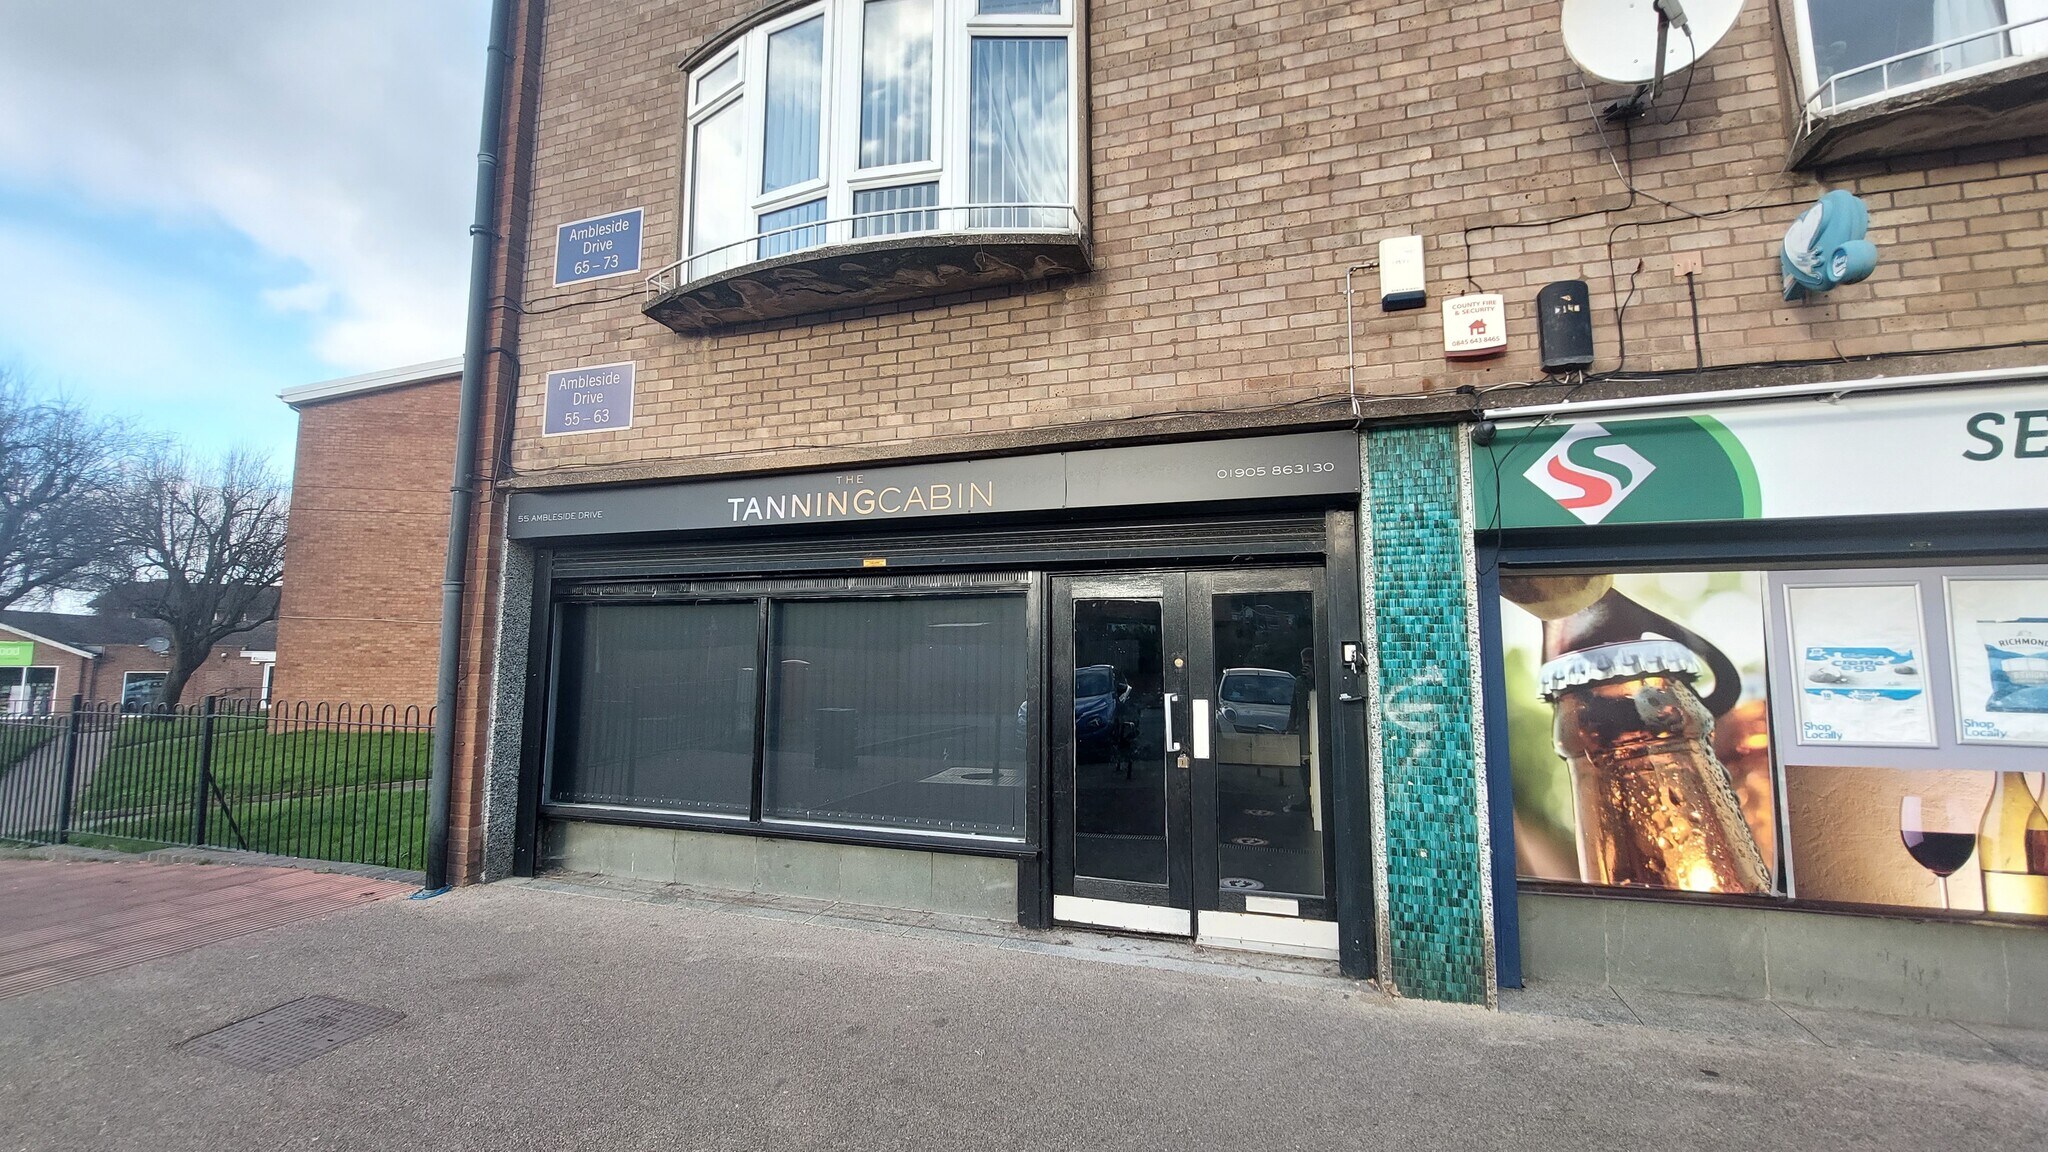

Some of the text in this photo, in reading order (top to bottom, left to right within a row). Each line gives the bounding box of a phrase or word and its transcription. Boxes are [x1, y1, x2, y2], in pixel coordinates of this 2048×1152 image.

[569, 218, 630, 242] Ambleside
[583, 239, 613, 255] Drive
[574, 260, 590, 275] 65
[604, 254, 619, 270] 73
[1451, 301, 1480, 310] COUNTY
[1462, 306, 1496, 315] SECURITY
[1451, 339, 1469, 347] 0845
[559, 371, 620, 391] Ambleside
[573, 391, 604, 406] Drive
[564, 411, 580, 426] 55
[593, 408, 610, 423] 63
[1216, 462, 1335, 479] 01905 863130
[836, 474, 864, 485] THE
[517, 510, 603, 523] 55 AMBLESIDE DRIVE
[1803, 721, 1832, 732] Shop
[1963, 718, 1995, 729] Shop
[1804, 731, 1843, 740] Locally
[1964, 728, 2008, 738] Locally
